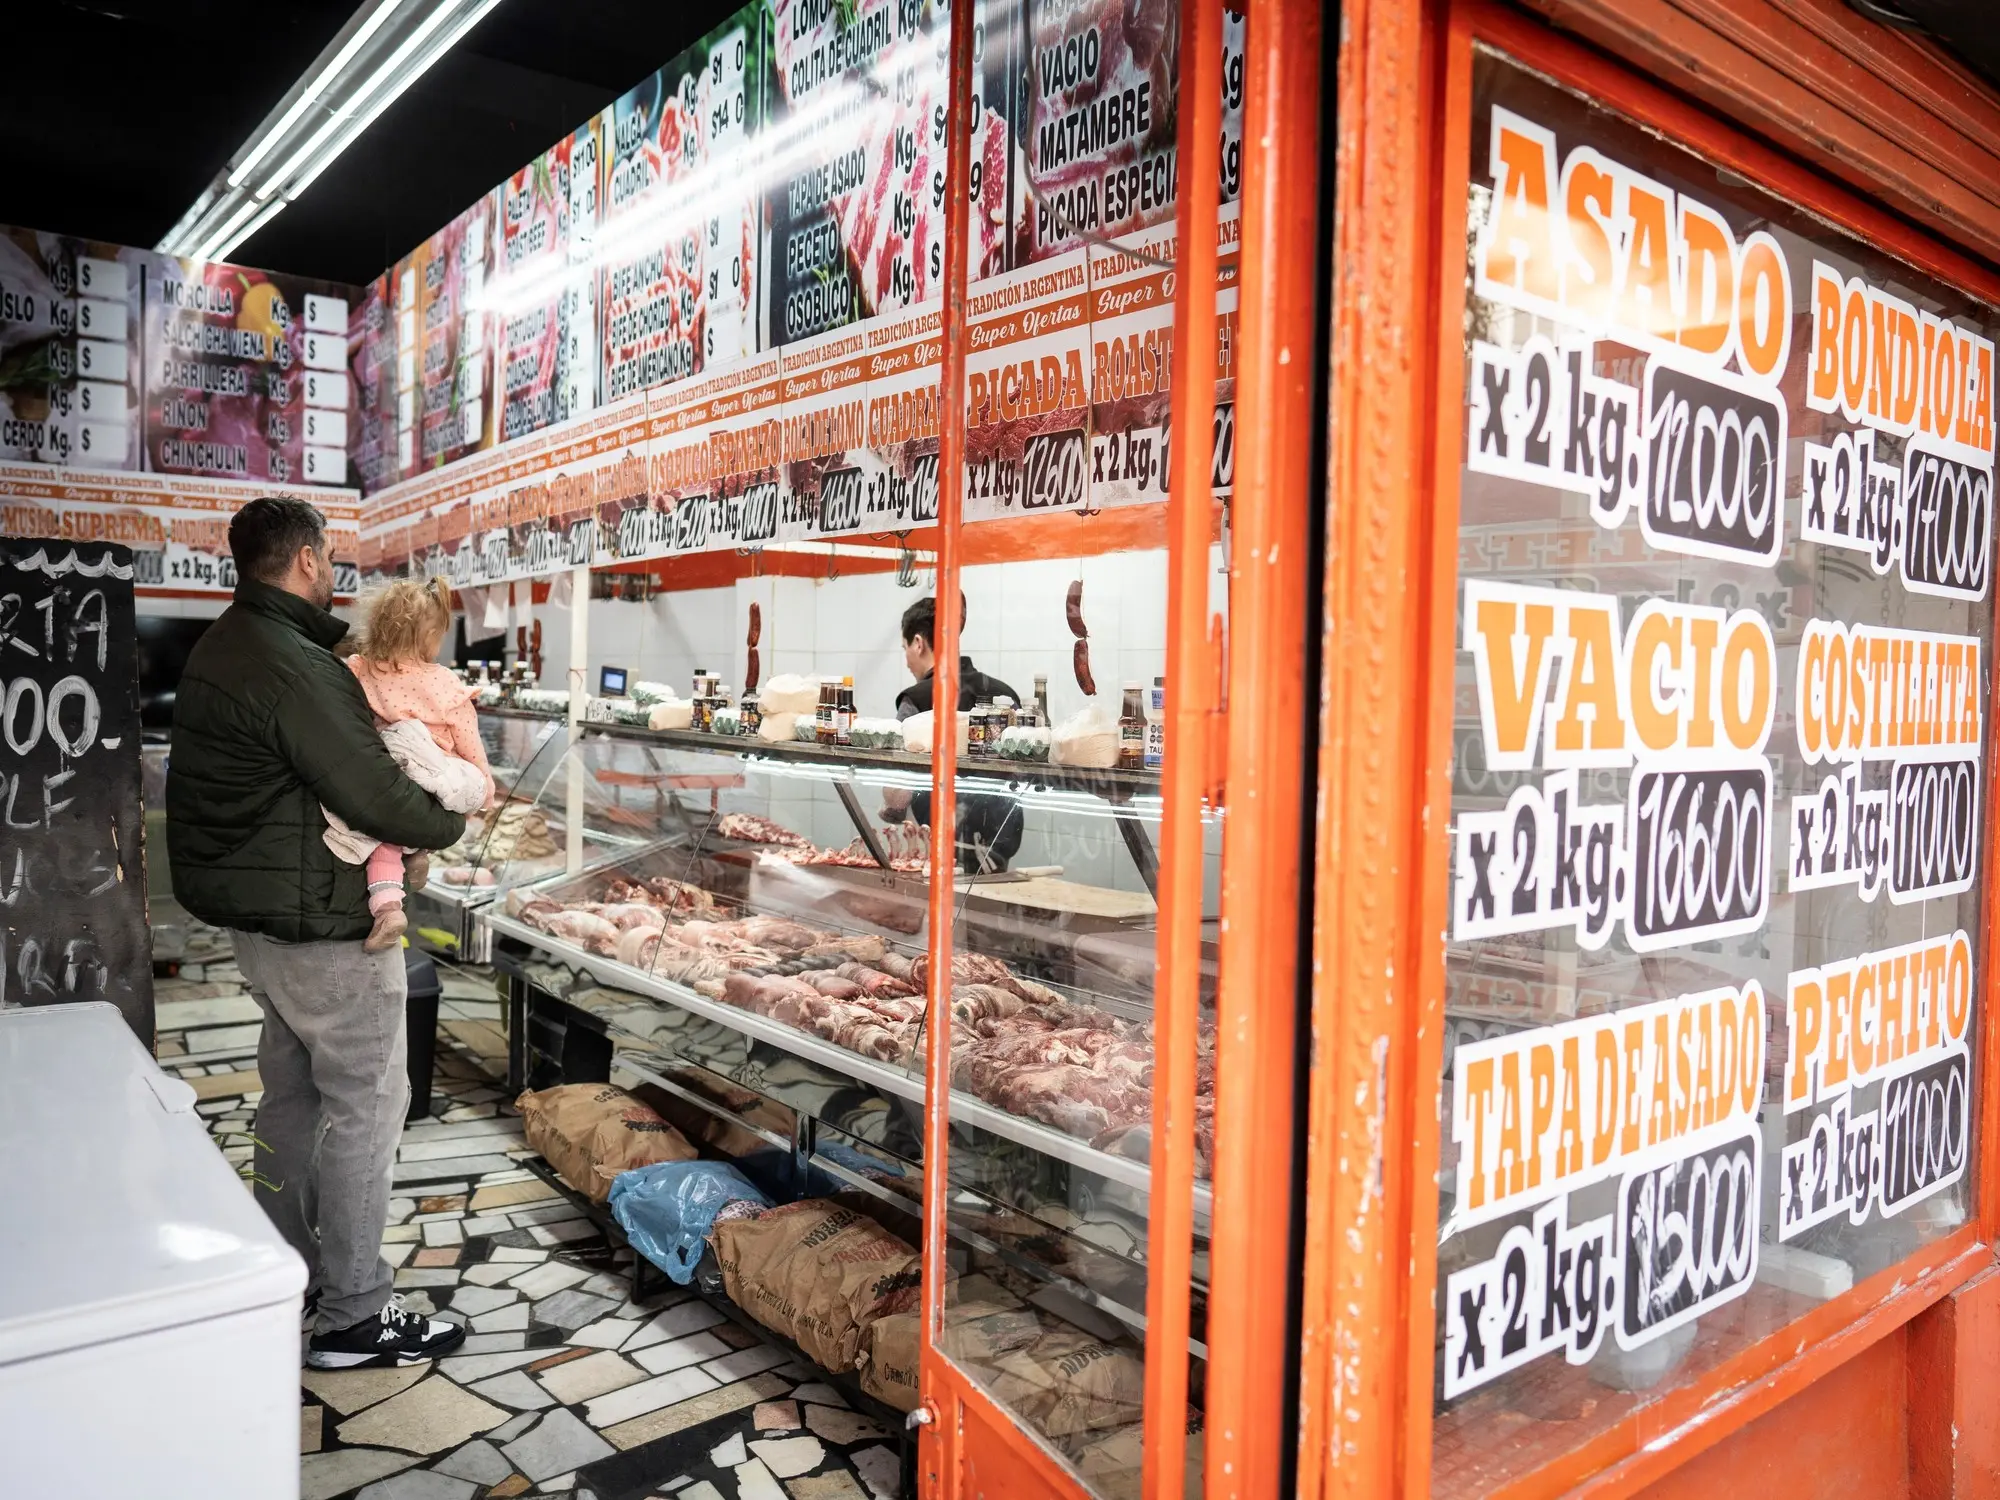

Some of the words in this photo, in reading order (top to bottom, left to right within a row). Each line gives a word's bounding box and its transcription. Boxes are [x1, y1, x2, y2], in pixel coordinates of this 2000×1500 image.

[792, 45, 825, 100] COLITA
[829, 34, 842, 78] DE
[845, 5, 892, 69] CUADRIL
[1041, 28, 1100, 98] VACIO
[615, 112, 642, 150] NALGA
[1039, 81, 1150, 173] MATAMBRE
[789, 176, 813, 217] TAPA
[815, 164, 829, 206] DE
[831, 145, 866, 196] ASADO
[895, 125, 918, 175] Kg.
[787, 220, 838, 276] PECETO
[893, 191, 916, 240] Kg.
[1037, 180, 1099, 248] PICADA
[82, 263, 92, 287] $
[633, 249, 663, 288] ANCHO
[681, 236, 696, 275] Kg.
[1484, 125, 1786, 377] ASADO
[0, 292, 35, 323] SLO
[50, 300, 74, 334] Kg.
[81, 304, 91, 329] $
[309, 301, 317, 322] $
[787, 276, 849, 335] OSOBUCO
[892, 256, 916, 306] Kg.
[931, 239, 941, 283] $
[966, 280, 1022, 318] TRADICIÓN
[1023, 263, 1085, 305] ARGENTINA
[1097, 279, 1156, 314] Super
[612, 315, 627, 350] BIFE
[628, 311, 638, 342] DE
[639, 295, 671, 337] CHORIZO
[680, 286, 695, 326] Kg.
[867, 316, 913, 349] TRADICIÓN
[971, 320, 1017, 348] Super
[1022, 304, 1081, 337] Ofertas
[81, 346, 91, 370] $
[308, 340, 317, 361] $
[611, 364, 626, 398] BIFE
[627, 359, 637, 394] DE
[707, 327, 714, 357] $
[782, 343, 821, 373] TRADICIÓN
[821, 333, 864, 365] ARGENTINA
[870, 351, 911, 376] Super
[1812, 275, 1992, 453] BONDIOLA
[50, 384, 73, 417] Kg.
[81, 387, 91, 411] $
[162, 360, 246, 394] PARRILLERA
[308, 377, 317, 399] $
[711, 400, 739, 418] Super
[742, 388, 777, 409] Ofertas
[785, 379, 818, 399] Super
[821, 365, 861, 389] Ofertas
[967, 348, 1088, 430] PICADA
[3, 420, 45, 449] CERDO
[50, 426, 73, 458] Kg.
[81, 428, 91, 451] $
[307, 415, 316, 437] $
[868, 383, 942, 450] CUADRA
[1480, 361, 1511, 460] x
[1524, 352, 1552, 468] 2
[1564, 349, 1640, 514] kg.
[1649, 389, 1773, 540] 12000
[307, 452, 316, 474] $
[650, 440, 710, 494] OSOBUCO
[709, 419, 782, 480] ESPINAZO
[967, 464, 979, 499] x
[980, 454, 990, 498] 2
[992, 447, 1020, 507] kg.
[1093, 444, 1105, 484] x
[1108, 432, 1120, 479] 2
[1123, 425, 1157, 491] kg.
[709, 507, 716, 534] x
[724, 494, 741, 541] kg.
[781, 495, 790, 525] x
[790, 486, 798, 523] 2
[799, 480, 819, 531] kg.
[867, 481, 876, 513] x
[876, 471, 886, 511] 2
[887, 465, 910, 518] kg.
[1807, 457, 1827, 532] x
[1833, 446, 1850, 537] 2
[1856, 442, 1901, 568] kg.
[1907, 453, 1988, 589] 17000
[62, 509, 166, 541] SUPREMA
[171, 561, 180, 578] x
[182, 558, 190, 578] 2
[193, 556, 217, 584] kg.
[1476, 599, 1771, 755] VACIO
[1802, 631, 1980, 753] COSTILLITA
[1467, 830, 1496, 923] x
[1511, 803, 1539, 917] 2
[1550, 788, 1626, 936] kg.
[1640, 772, 1763, 931] 16600
[1795, 808, 1815, 879] x
[1820, 787, 1838, 874] 2
[1843, 774, 1889, 892] kg.
[1896, 761, 1971, 892] 11000
[1790, 938, 1970, 1102] PECHITO
[1466, 1034, 1585, 1211] TAPA
[1591, 1019, 1645, 1166] DE
[1647, 989, 1760, 1145] ASADO
[1786, 1152, 1805, 1226] x
[1811, 1125, 1829, 1216] 2
[1834, 1101, 1880, 1214] kg.
[1887, 1063, 1965, 1201] 11000
[1457, 1281, 1487, 1380] x
[1501, 1245, 1528, 1360] 2
[1540, 1218, 1615, 1352] kg.
[1630, 1149, 1753, 1333] 15000
